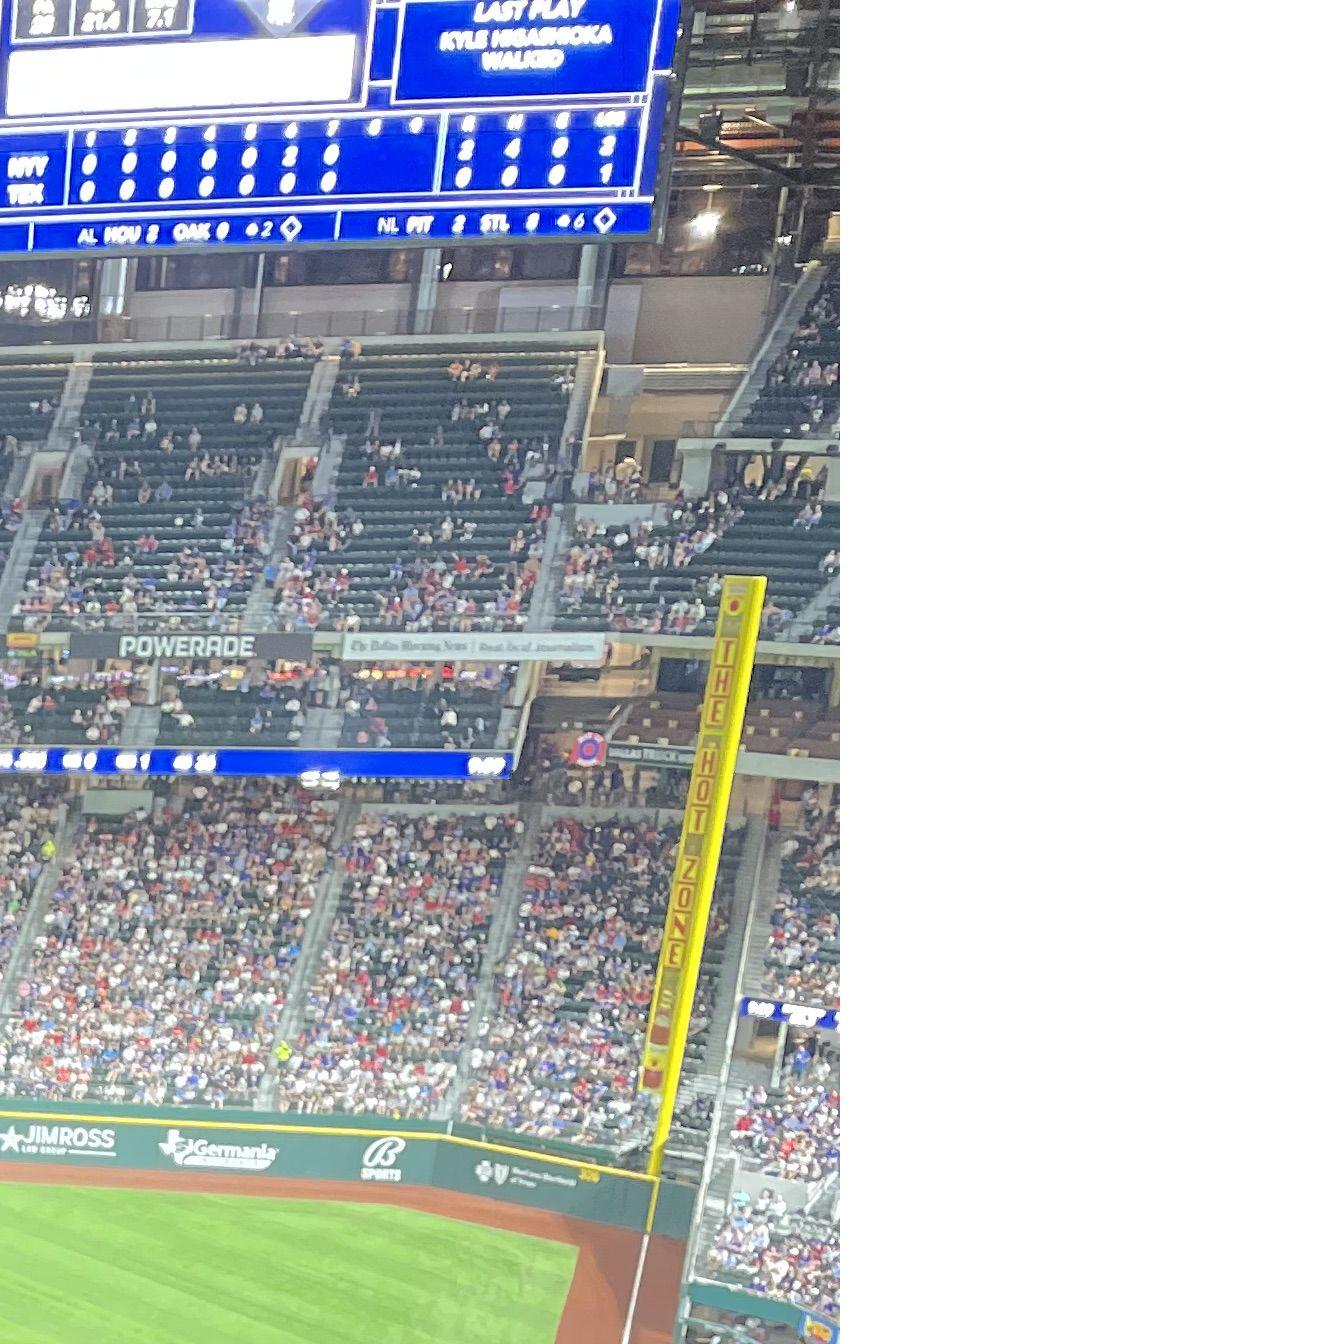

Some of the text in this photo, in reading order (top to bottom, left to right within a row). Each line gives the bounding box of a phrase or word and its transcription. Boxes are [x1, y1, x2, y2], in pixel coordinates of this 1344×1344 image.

[77, 228, 99, 247] AL
[261, 221, 274, 239] 2
[377, 216, 399, 235] NL
[573, 212, 585, 231] 6
[119, 634, 256, 658] POWERADE
[666, 638, 736, 967] THE HOT ZONE
[195, 1139, 278, 1160] Germania
[361, 1166, 402, 1182] SPORTS
